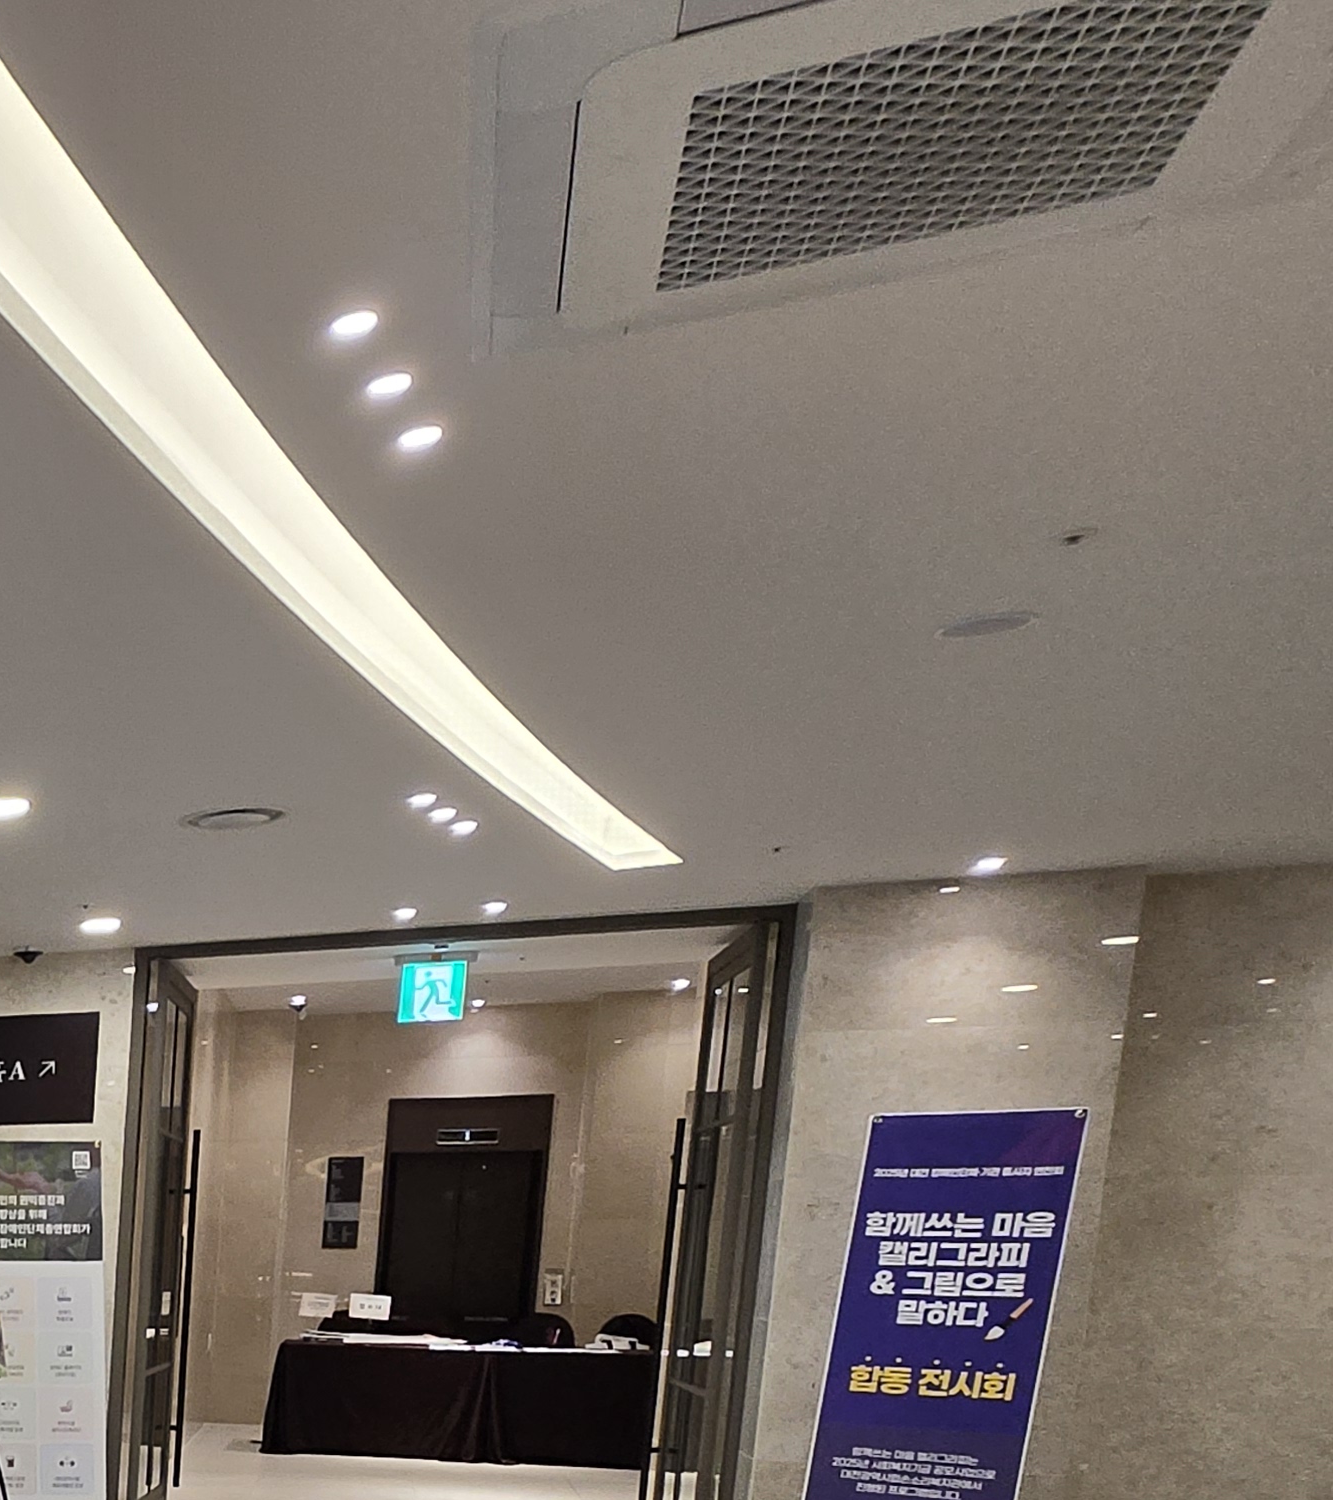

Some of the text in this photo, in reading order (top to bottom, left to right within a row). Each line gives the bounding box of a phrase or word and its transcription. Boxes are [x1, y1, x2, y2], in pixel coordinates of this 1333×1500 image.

[865, 1211, 1056, 1238] 함께쓰는 마음
[878, 1241, 1031, 1268] 캘리그라피
[869, 1270, 1026, 1297] & 그림으로
[896, 1300, 989, 1327] 말하다
[849, 1364, 1016, 1401] 합동 전시회
